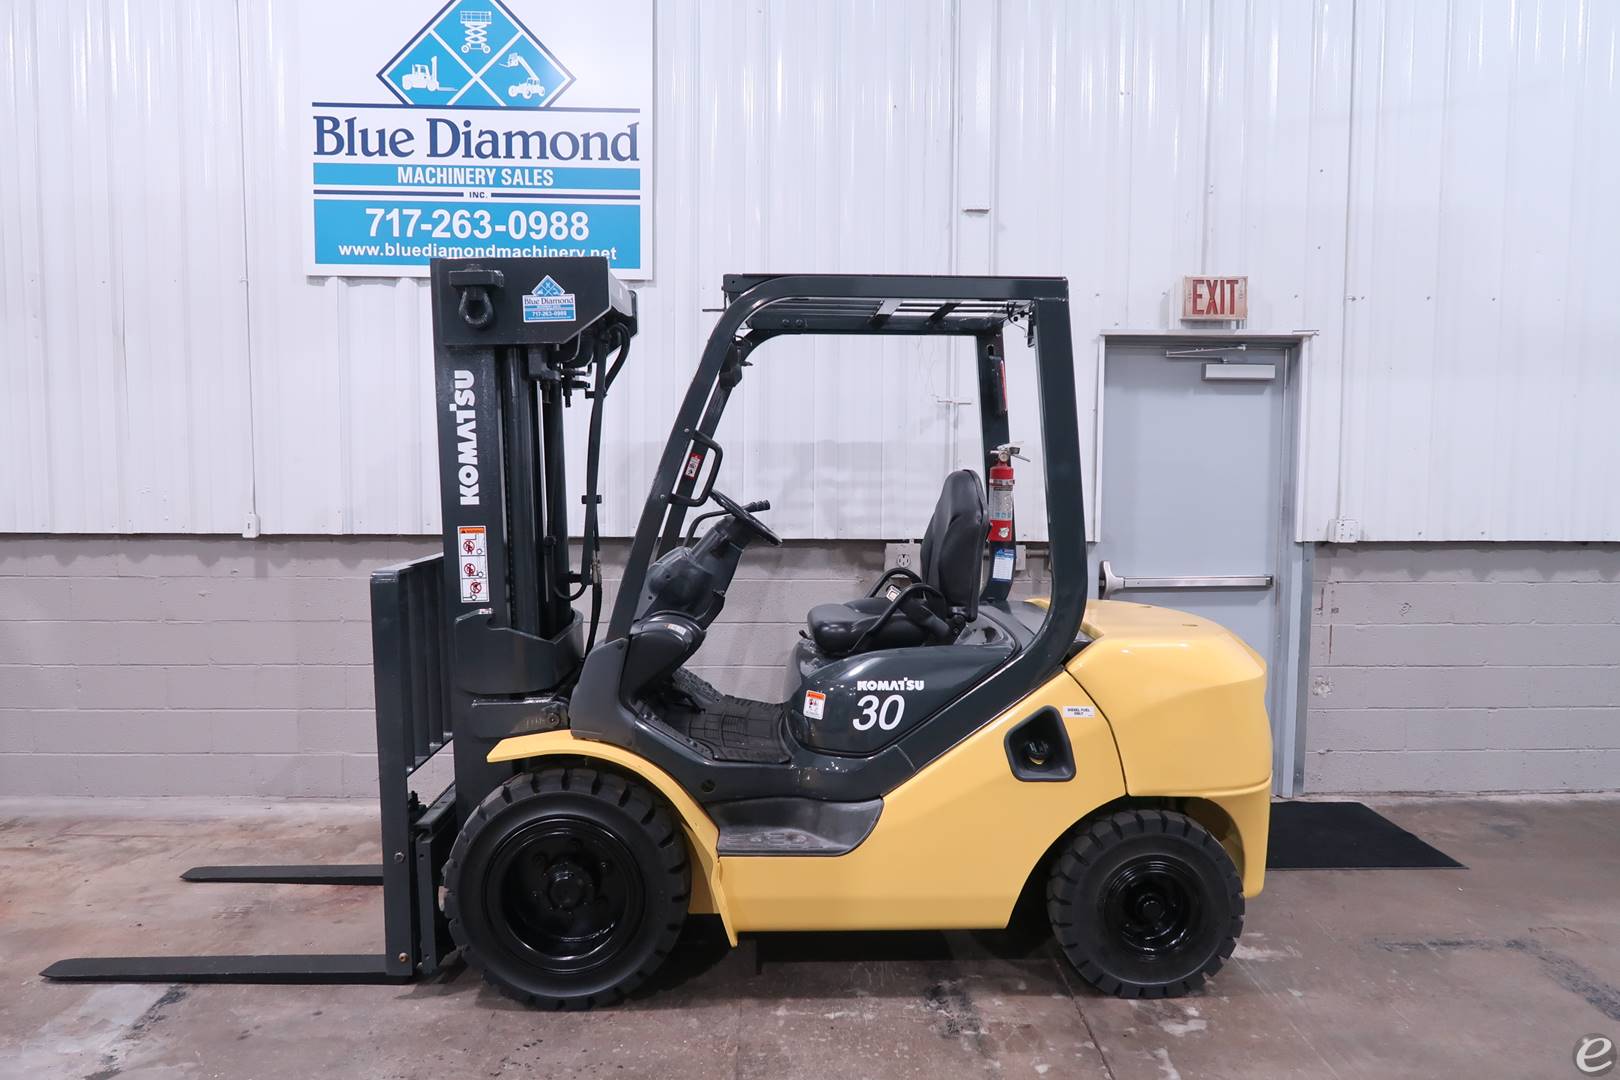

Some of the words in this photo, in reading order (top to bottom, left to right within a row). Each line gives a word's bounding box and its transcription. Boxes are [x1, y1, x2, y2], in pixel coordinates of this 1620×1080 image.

[313, 115, 415, 159] Blue
[426, 117, 640, 162] Diamond
[397, 166, 496, 186] MACHINERY
[501, 168, 554, 187] SALES
[468, 191, 489, 199] INC.
[365, 207, 590, 241] 717-263-0988
[338, 242, 617, 260] www.bluediamondmachinerynet
[1191, 279, 1239, 315] EXIT
[450, 370, 480, 505] KOMATSU
[857, 677, 925, 691] KOMATSU
[852, 694, 905, 731] 30
